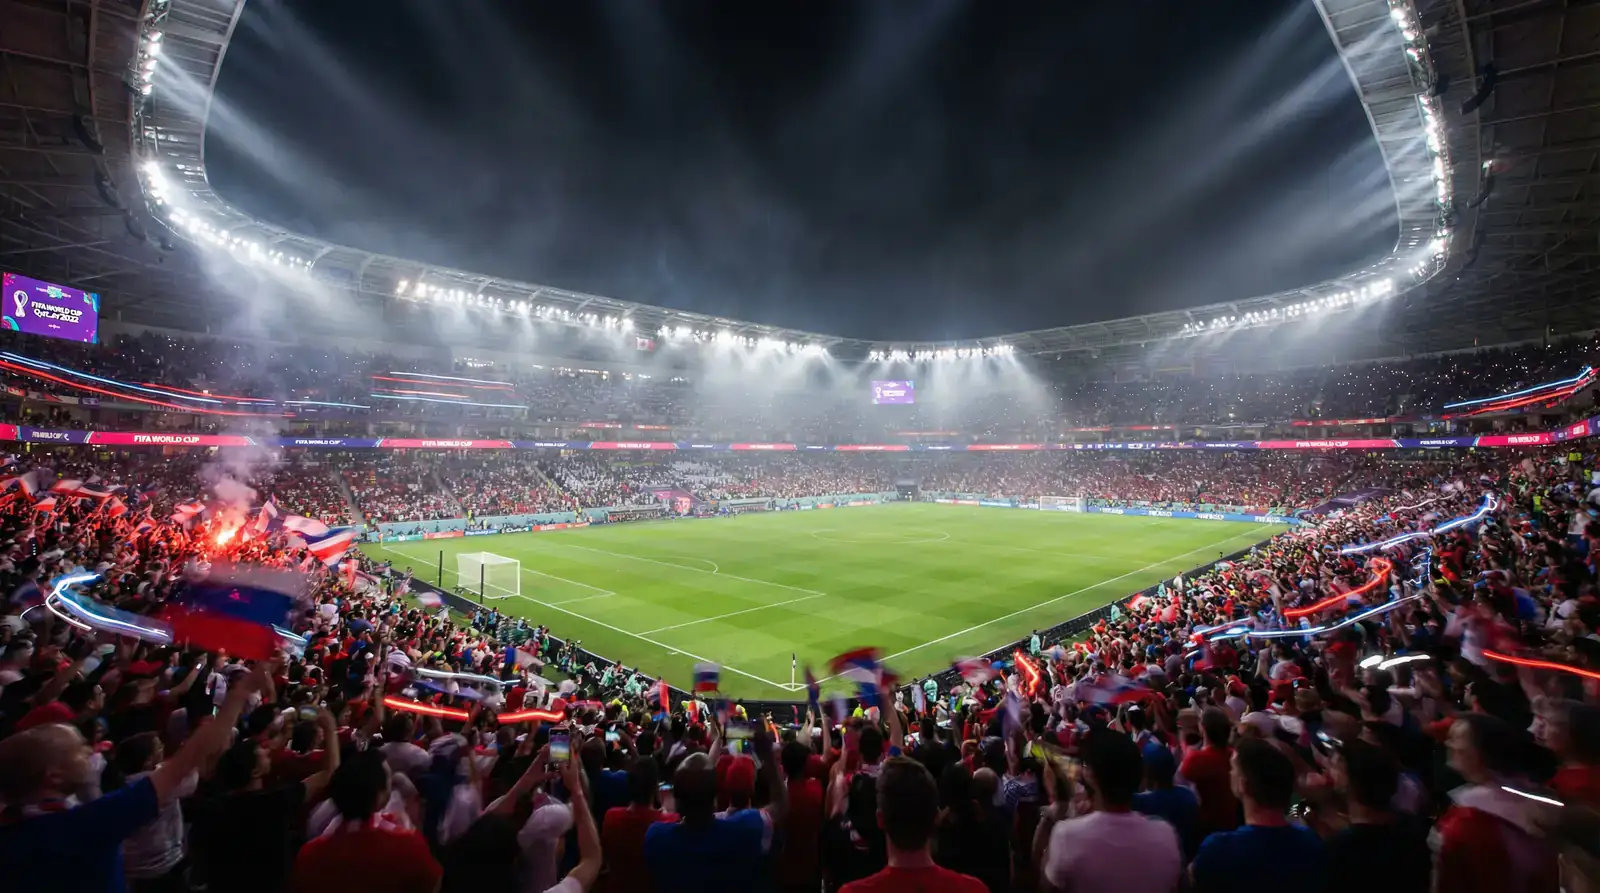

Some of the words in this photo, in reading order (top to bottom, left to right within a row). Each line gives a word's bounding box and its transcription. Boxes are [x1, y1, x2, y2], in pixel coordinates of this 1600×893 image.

[134, 435, 152, 443] FIFA
[152, 435, 183, 444] WORLD
[183, 436, 200, 444] CUP
